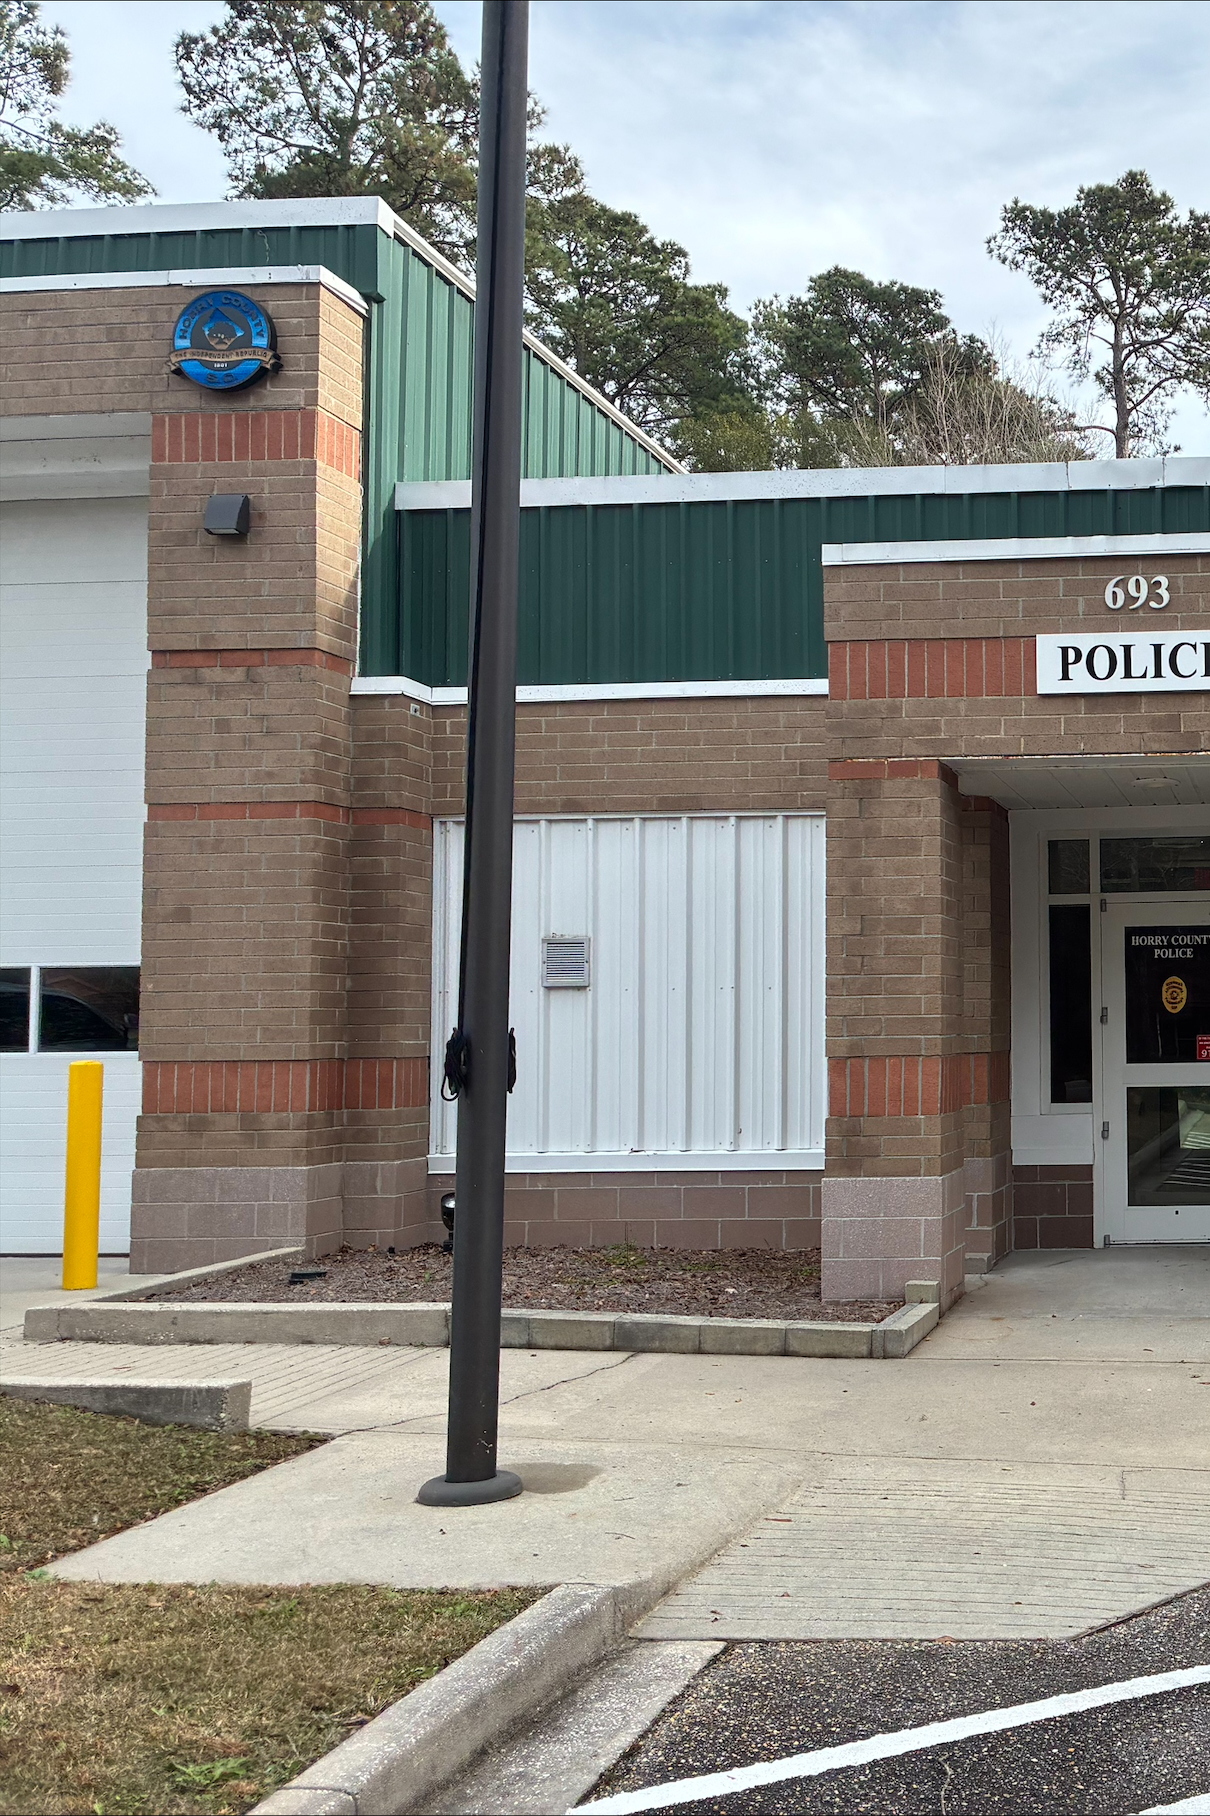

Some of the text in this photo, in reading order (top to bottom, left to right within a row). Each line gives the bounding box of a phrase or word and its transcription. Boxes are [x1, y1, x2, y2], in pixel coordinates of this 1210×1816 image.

[179, 295, 265, 339] HORRY COUNTY
[190, 351, 233, 359] INDEPENDENT
[235, 350, 267, 358] REPUBLIC
[1104, 575, 1171, 610] 693
[1131, 935, 1169, 946] HORRY
[1154, 948, 1194, 959] POLICE
